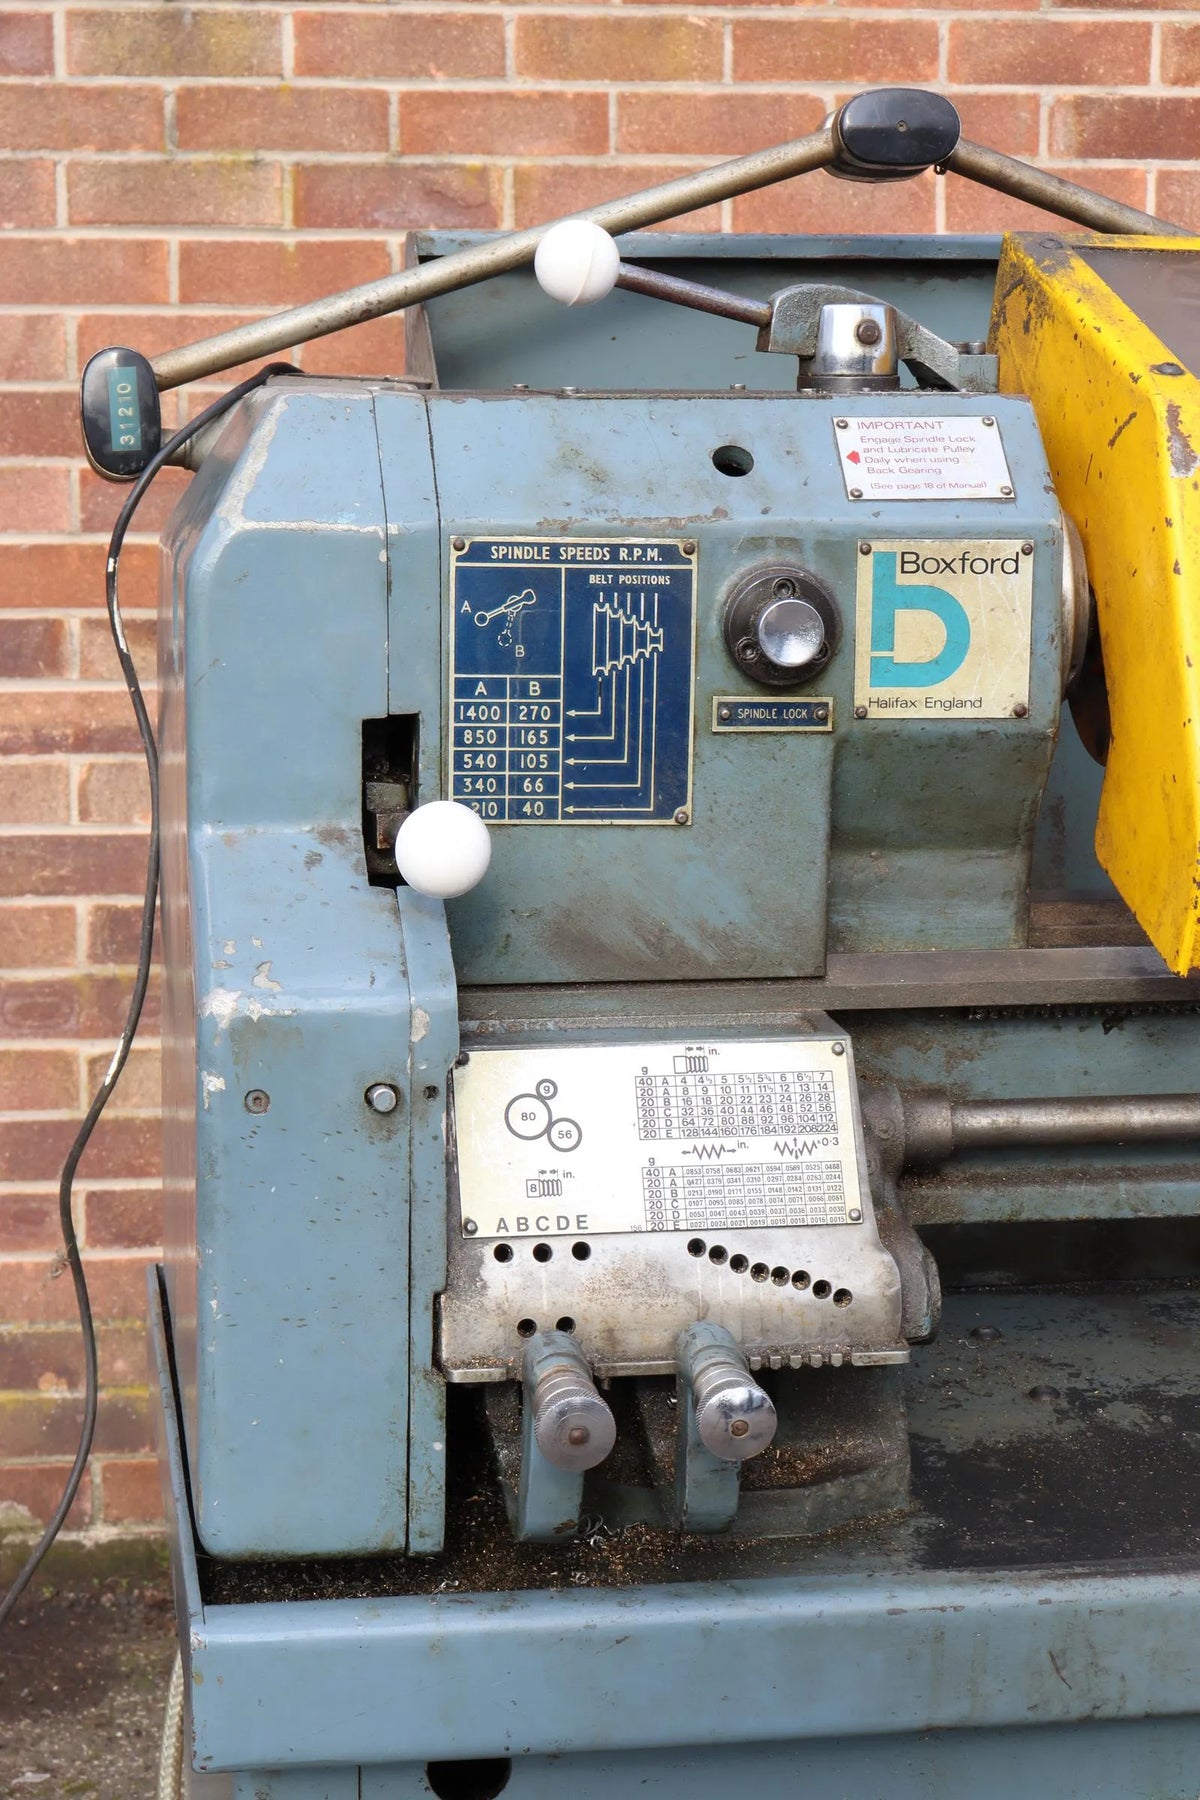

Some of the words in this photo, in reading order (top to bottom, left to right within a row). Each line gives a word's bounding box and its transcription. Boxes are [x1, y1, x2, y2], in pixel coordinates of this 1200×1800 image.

[857, 421, 944, 430] IMPORTANT
[860, 436, 901, 445] Engage
[904, 435, 945, 444] Spindle
[943, 445, 975, 455] Pulley
[865, 456, 890, 465] Daily
[894, 456, 926, 464] when
[929, 456, 960, 465] using
[867, 466, 894, 474] Back
[899, 466, 942, 475] Gearing
[491, 546, 550, 560] SPINDLE
[560, 548, 610, 560] SPEEDS
[620, 548, 662, 562] R.P.M.
[900, 552, 1019, 575] Boxford
[589, 575, 613, 584] BELT
[619, 575, 670, 585] POSITIONS
[461, 600, 471, 612] A
[516, 646, 524, 657] B
[475, 682, 487, 695] A
[530, 682, 540, 695] B
[869, 697, 916, 709] Halifax
[925, 697, 982, 712] England
[460, 706, 500, 720] 1400
[519, 706, 550, 720] 270
[738, 709, 777, 718] SPINDLE
[784, 709, 807, 718] LOCK
[464, 730, 496, 744] 850
[520, 730, 548, 744] 165
[463, 754, 496, 768] 540
[520, 754, 548, 768] 105
[463, 778, 496, 792] 340
[524, 778, 543, 792] 66
[522, 802, 544, 815] 40
[708, 1047, 720, 1055] in.
[639, 1078, 652, 1086] 40
[682, 1087, 689, 1095] 8
[641, 1098, 654, 1106] 20
[720, 1096, 733, 1104] 20
[759, 1095, 772, 1103] 23
[521, 1112, 536, 1121] 80
[642, 1109, 655, 1117] 20
[664, 1108, 671, 1116] C
[701, 1107, 714, 1115] 36
[721, 1117, 735, 1125] 80
[781, 1115, 794, 1123] 96
[558, 1131, 572, 1139] 56
[643, 1130, 656, 1138] 20
[799, 1125, 817, 1133] 208
[563, 1170, 575, 1178] in.
[669, 1168, 676, 1176] A
[648, 1190, 661, 1198] 20
[671, 1200, 679, 1208] C
[496, 1218, 509, 1232] A
[517, 1217, 529, 1232] B
[536, 1216, 550, 1230] C
[557, 1216, 569, 1230] D
[576, 1215, 588, 1229] E
[651, 1222, 664, 1230] 20
[674, 1221, 680, 1230] E
